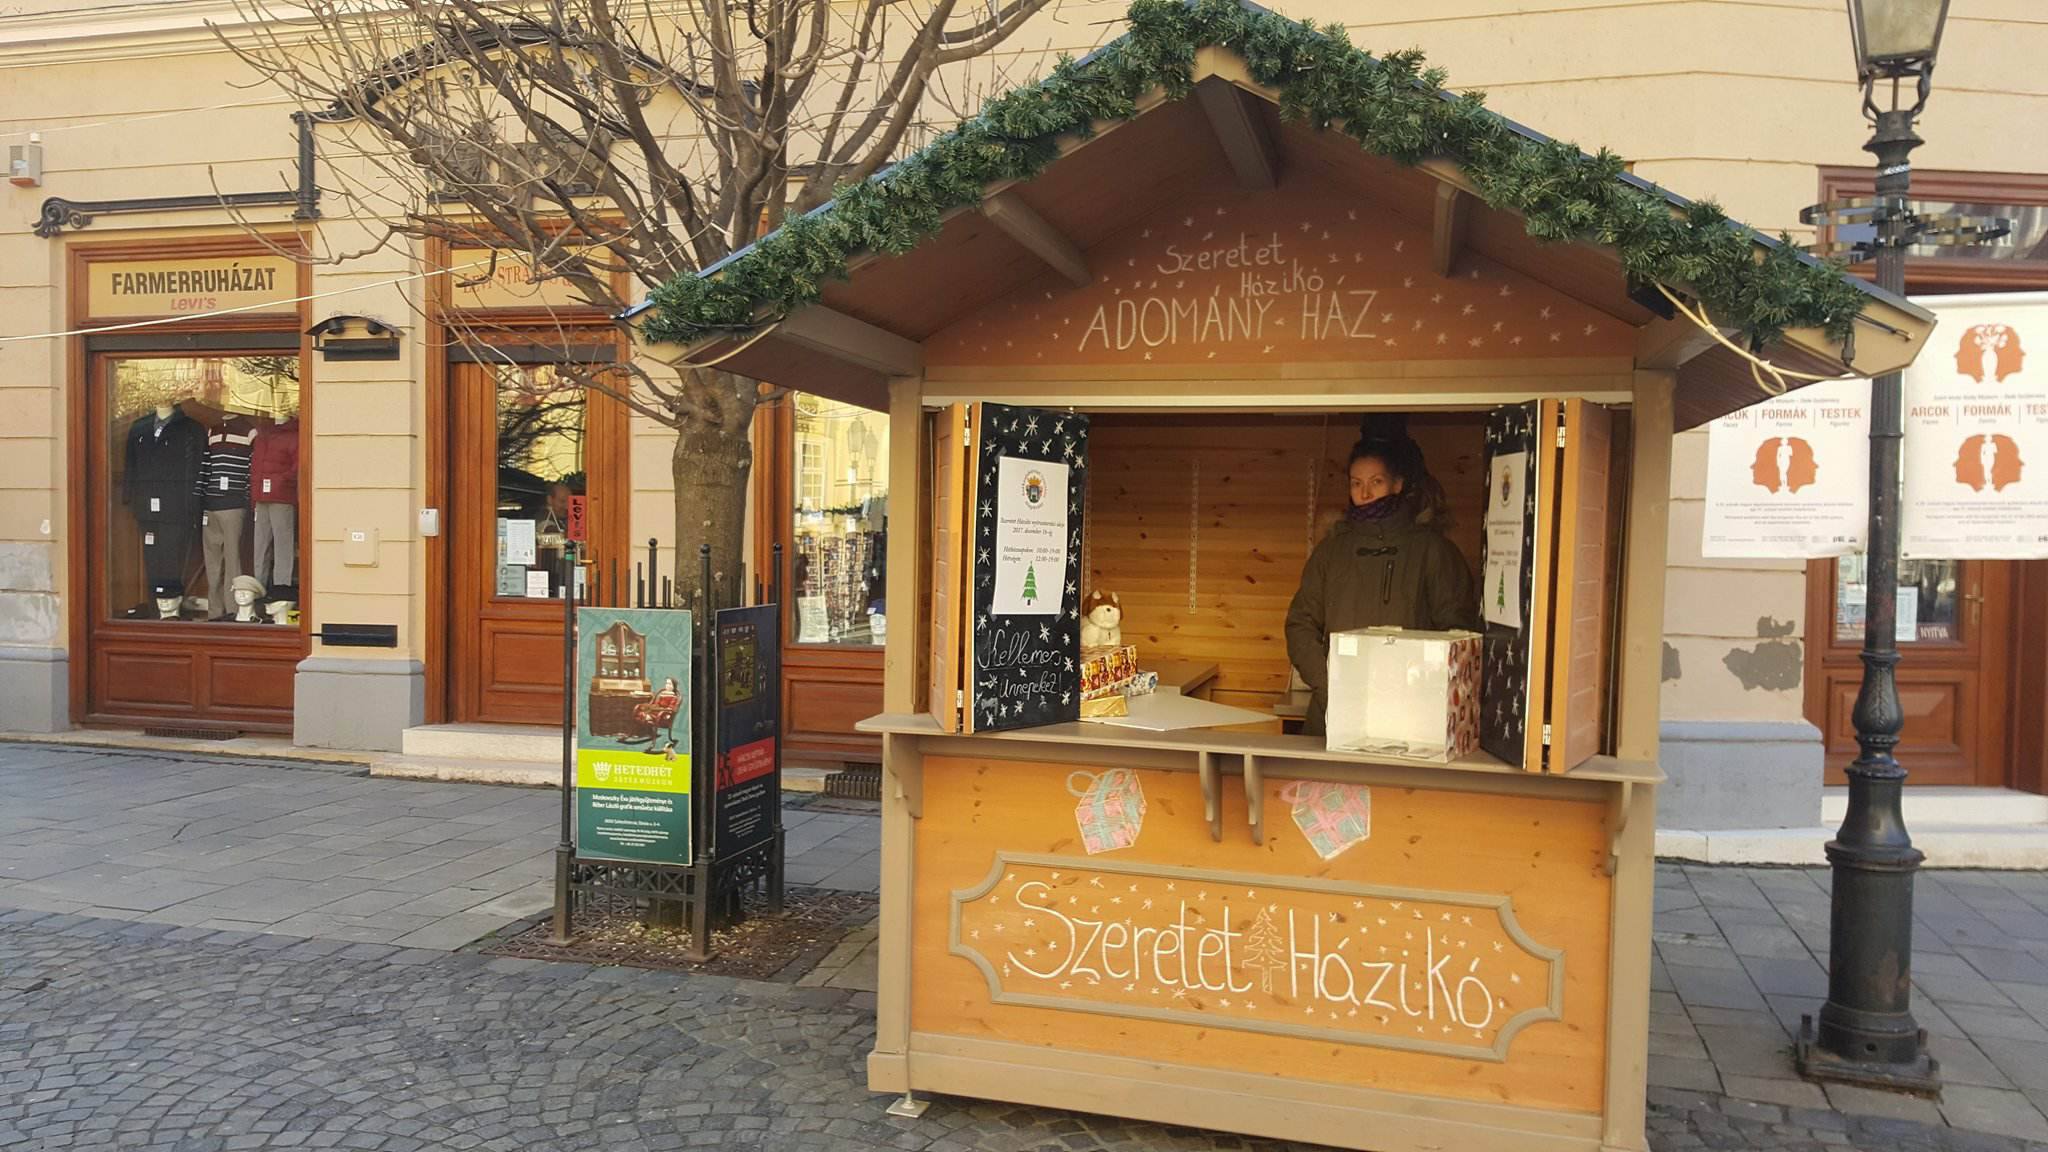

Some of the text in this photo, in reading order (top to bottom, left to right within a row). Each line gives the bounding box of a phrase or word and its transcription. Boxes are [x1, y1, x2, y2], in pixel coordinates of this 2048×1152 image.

[1157, 232, 1286, 274] Szeretet
[111, 262, 276, 295] FARMERRUHÁZAT
[1240, 258, 1324, 298] Házikó
[1078, 274, 1377, 352] ADOMÁNY HÁZ
[1762, 407, 1807, 419] FORMÁK
[1820, 407, 1862, 419] TESTEK
[1911, 405, 1950, 417] ARCOK
[1963, 403, 2012, 416] FORMÁK
[1920, 626, 1949, 639] NYITVA
[977, 628, 1061, 669] Kellemes
[614, 763, 673, 777] HETEDHÉT
[1007, 880, 1495, 1030] Szeretet Házikó
